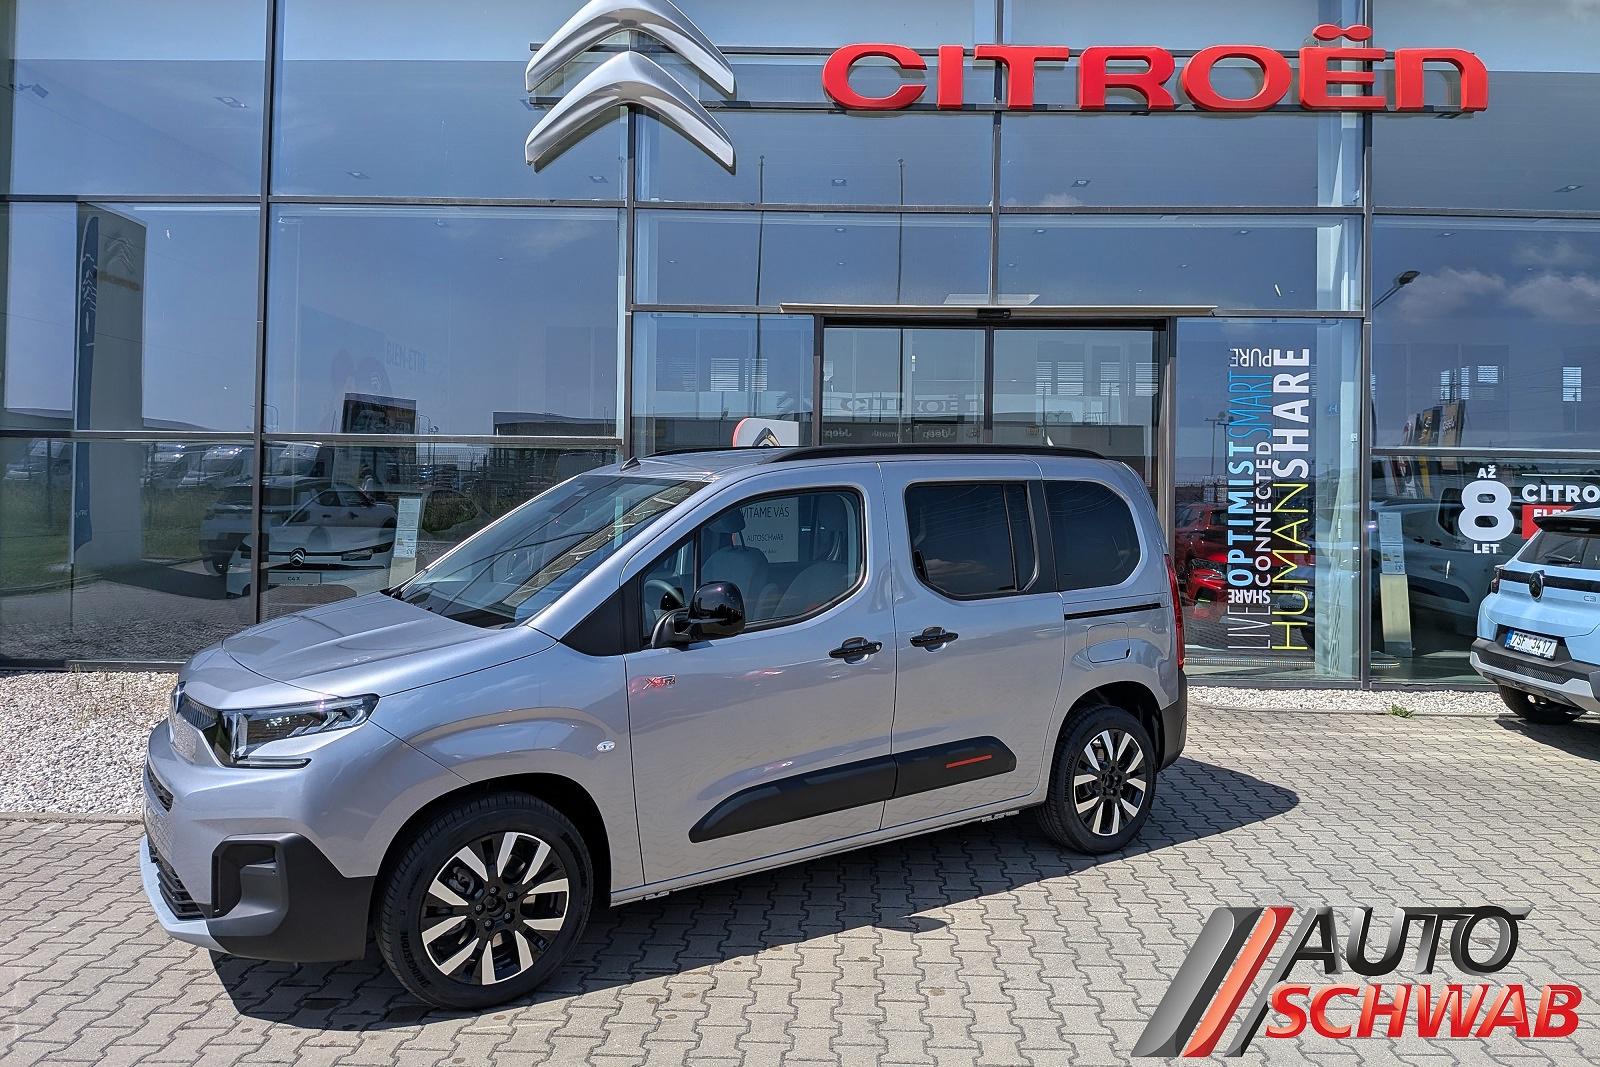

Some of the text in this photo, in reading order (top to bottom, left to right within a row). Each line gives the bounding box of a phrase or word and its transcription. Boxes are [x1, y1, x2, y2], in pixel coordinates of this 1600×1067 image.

[822, 23, 1489, 111] CITROËN
[1230, 348, 1272, 367] PURE
[1272, 348, 1310, 479] SHARE
[1227, 370, 1272, 587] OPTIMIST SMART
[1477, 464, 1497, 479] AŽ
[1521, 484, 1600, 503] CITRO
[1255, 441, 1272, 587] CONNECTED
[1458, 480, 1515, 541] 8
[1272, 483, 1309, 650] HUMAN
[1473, 543, 1500, 554] LET
[1227, 588, 1271, 604] SHARE
[1227, 605, 1271, 649] LIVE
